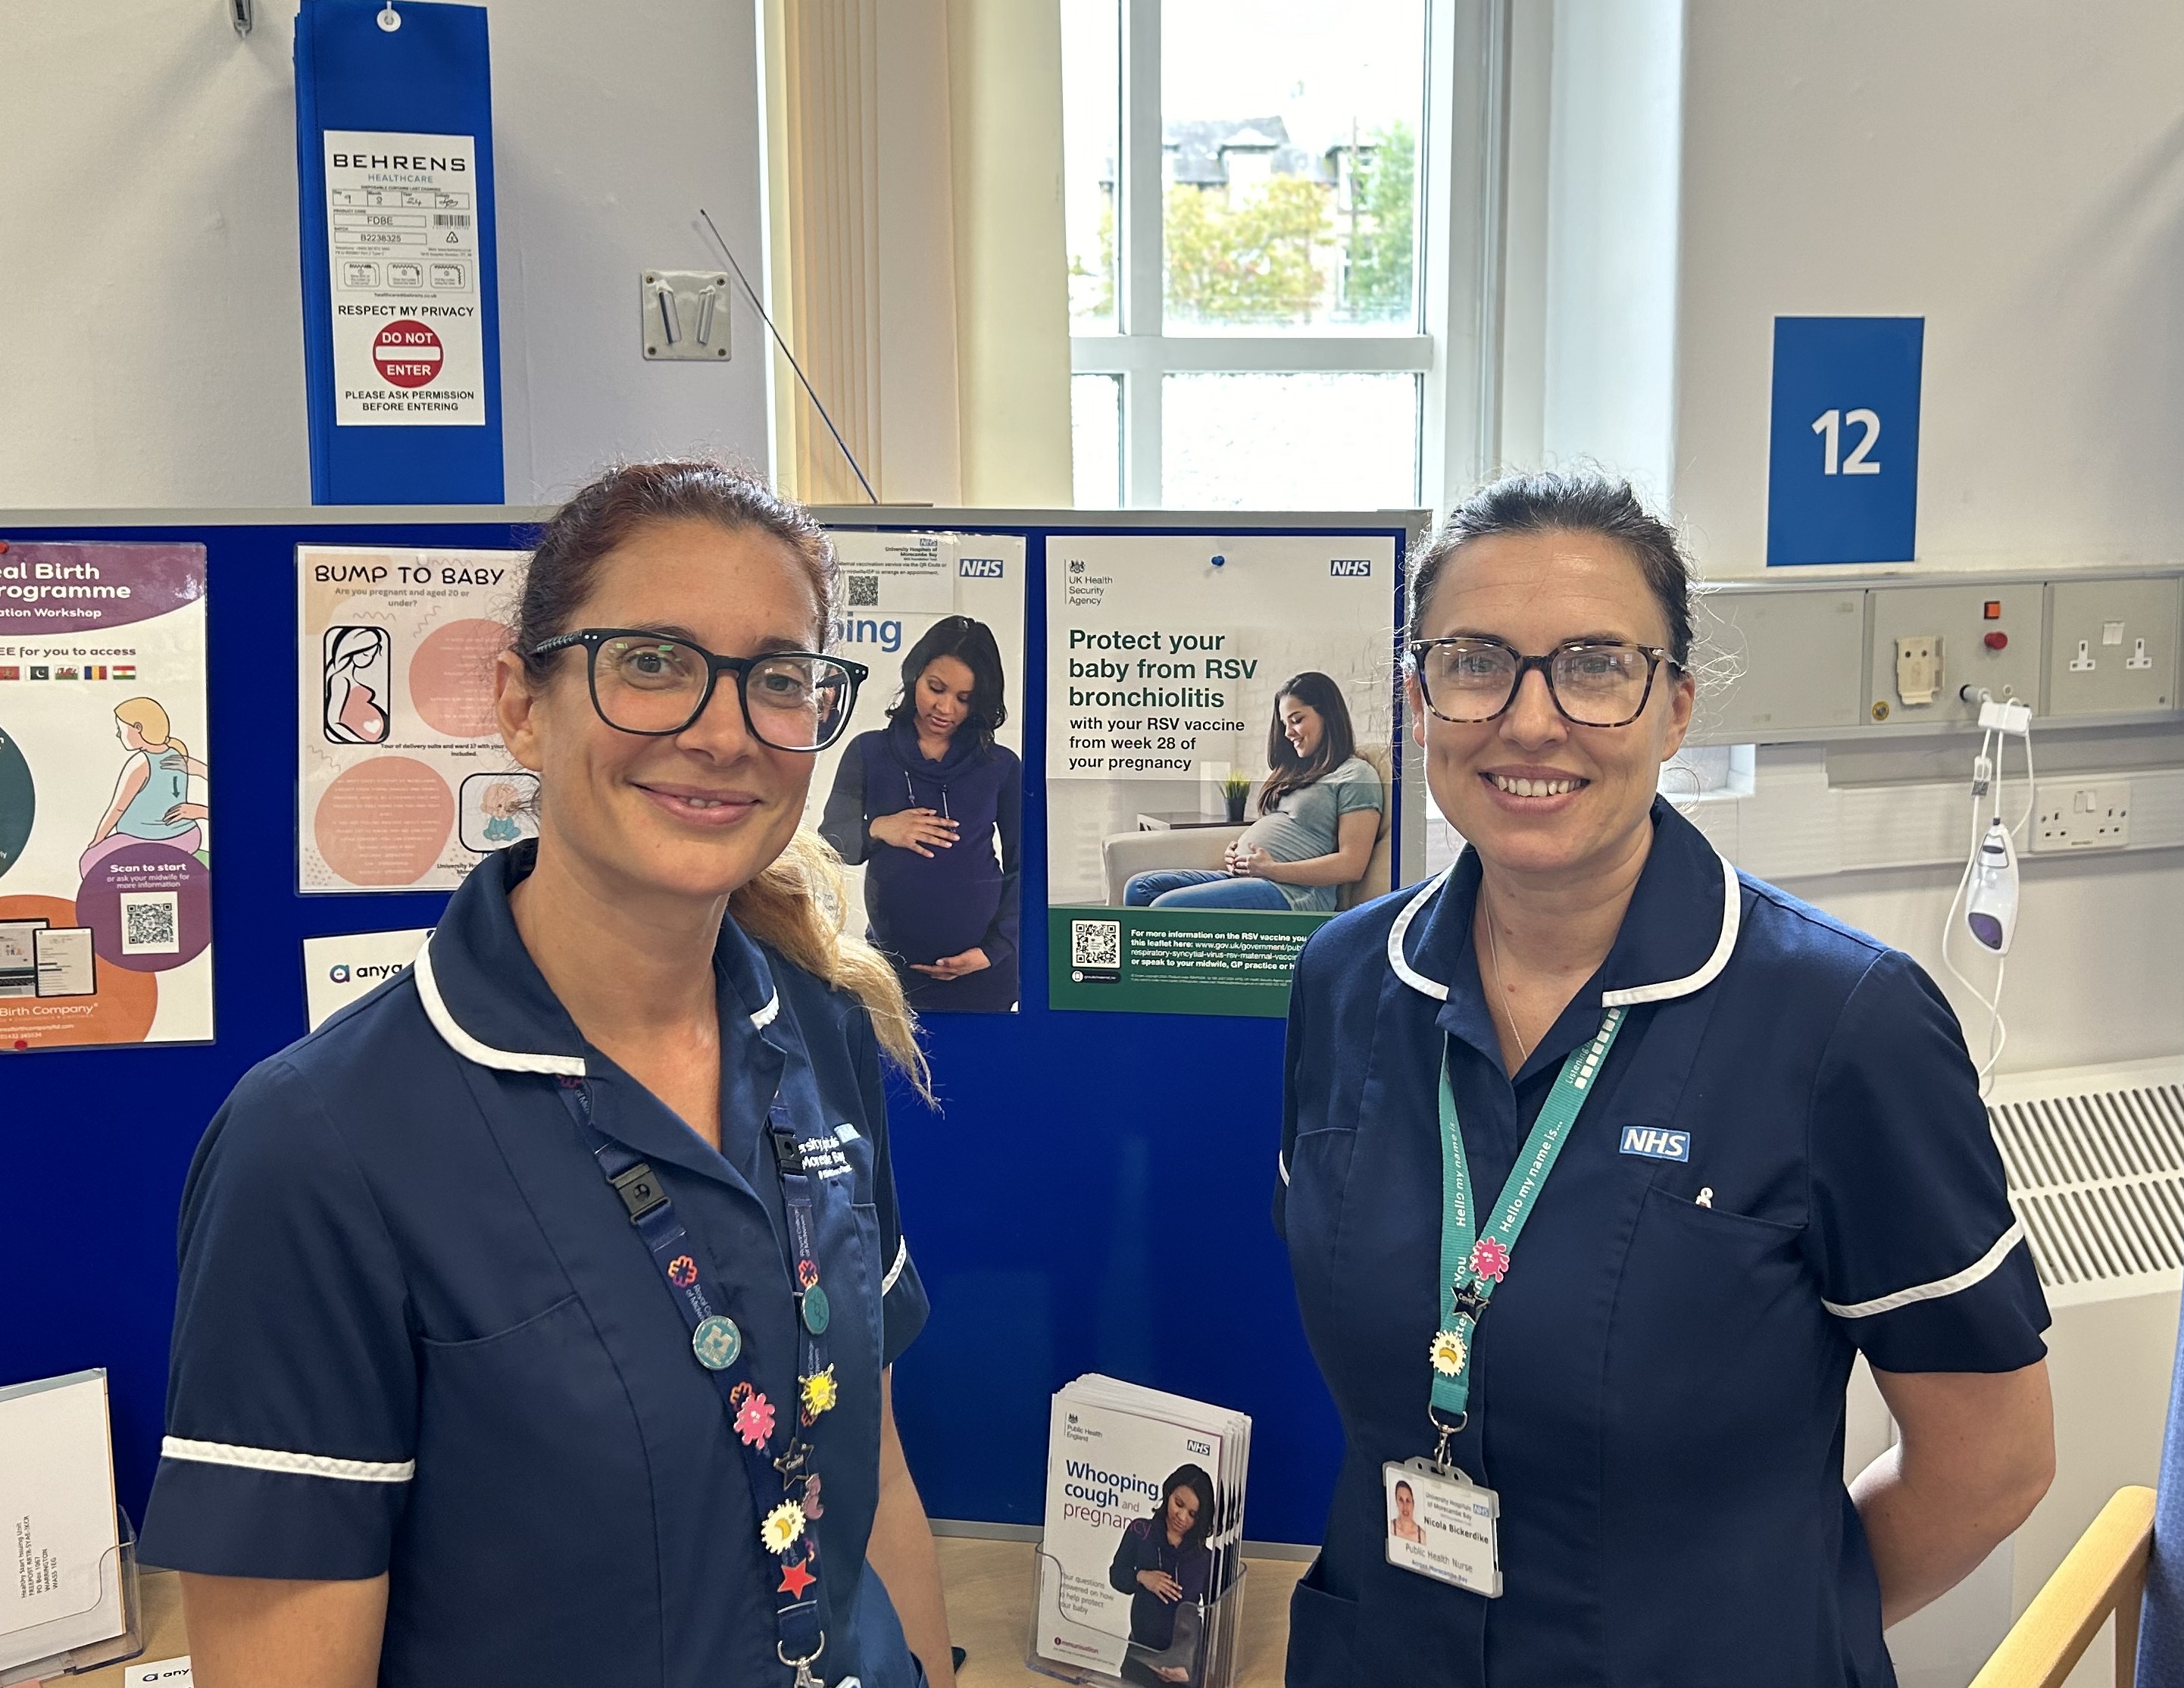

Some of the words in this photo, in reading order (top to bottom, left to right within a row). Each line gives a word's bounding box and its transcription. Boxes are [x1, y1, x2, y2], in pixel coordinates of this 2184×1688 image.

[333, 154, 466, 171] BEHRENS
[368, 173, 433, 183] HEALTHCARE
[367, 216, 393, 226] FDBE
[361, 234, 401, 242] B2238325
[338, 305, 396, 316] RESPECT
[400, 306, 417, 316] MY
[421, 307, 474, 317] PRIVACY
[382, 333, 402, 343] DO
[405, 333, 433, 343] NOT
[387, 364, 431, 376] ENTER
[345, 391, 386, 399] PLEASE
[388, 391, 409, 399] ASK
[412, 391, 474, 399] PERMISSION
[363, 402, 405, 411] BEFORE
[408, 402, 458, 411] ENTERING
[1811, 408, 1880, 475] 12
[36, 563, 100, 580] Birth
[315, 565, 388, 583] BUMP
[398, 567, 431, 583] TO
[442, 568, 505, 585] BABY
[960, 560, 1002, 577] NHS
[1332, 561, 1370, 576] NHS
[1069, 576, 1083, 584] UK
[1085, 576, 1113, 584] Health
[0, 585, 131, 602] rogramme
[426, 589, 446, 598] aged
[1069, 586, 1104, 596] Security
[1069, 596, 1101, 606] Agency
[35, 608, 102, 620] Workshop
[1070, 630, 1161, 650] Protect
[1169, 636, 1225, 655] your
[20, 647, 40, 658] for
[1070, 658, 1129, 683] baby
[1137, 658, 1195, 679] from
[1206, 659, 1258, 679] RSV
[1070, 686, 1224, 708] bronchiolitis
[1070, 717, 1102, 730] with
[1108, 720, 1142, 732] your
[1147, 717, 1179, 730] RSV
[1184, 718, 1245, 731] vaccine
[1069, 736, 1105, 749] from
[1111, 736, 1152, 749] week
[1158, 737, 1176, 749] 28
[1180, 737, 1196, 750] of
[1069, 758, 1104, 771] your
[1108, 758, 1192, 771] pregnancy
[110, 864, 140, 873] Scan
[1168, 930, 1213, 939] information
[1260, 933, 1291, 942] vaccine
[356, 964, 402, 979] anya
[1141, 959, 1165, 967] speak
[1195, 960, 1229, 969] midwife,
[1244, 961, 1278, 971] practice
[0, 1007, 30, 1016] Birth
[1565, 1048, 1590, 1084] Listening
[1623, 1128, 1687, 1157] NHS
[1451, 1133, 1462, 1168] name
[1456, 1170, 1465, 1190] my
[1498, 1198, 1523, 1233] Hello
[1518, 1177, 1536, 1199] my
[1529, 1141, 1551, 1177] name
[1544, 1121, 1564, 1141] is...
[1454, 1194, 1466, 1227] Hello
[1067, 1433, 1089, 1442] England
[1067, 1424, 1083, 1433] Public
[1085, 1428, 1103, 1438] Health
[1187, 1440, 1210, 1455] NHS
[1066, 1459, 1159, 1501] Whooping
[1065, 1483, 1118, 1508] cough
[1122, 1501, 1139, 1512] and
[1473, 1504, 1489, 1517] NHS
[1064, 1502, 1151, 1540] pregnancy
[1424, 1516, 1447, 1530] Nicola
[1448, 1524, 1489, 1544] Bickerdike
[1405, 1543, 1426, 1558] Public
[1428, 1550, 1450, 1565] Health
[1452, 1557, 1473, 1573] Nurse
[42, 1549, 50, 1592] WARRINGTON
[27, 1567, 35, 1596] FREEPOST
[36, 1584, 42, 1593] PO
[1076, 1576, 1104, 1589] questions
[1067, 1593, 1080, 1602] help
[1081, 1596, 1104, 1608] protect
[1100, 1592, 1114, 1601] how
[1073, 1603, 1088, 1615] baby
[164, 1669, 189, 1677] any
